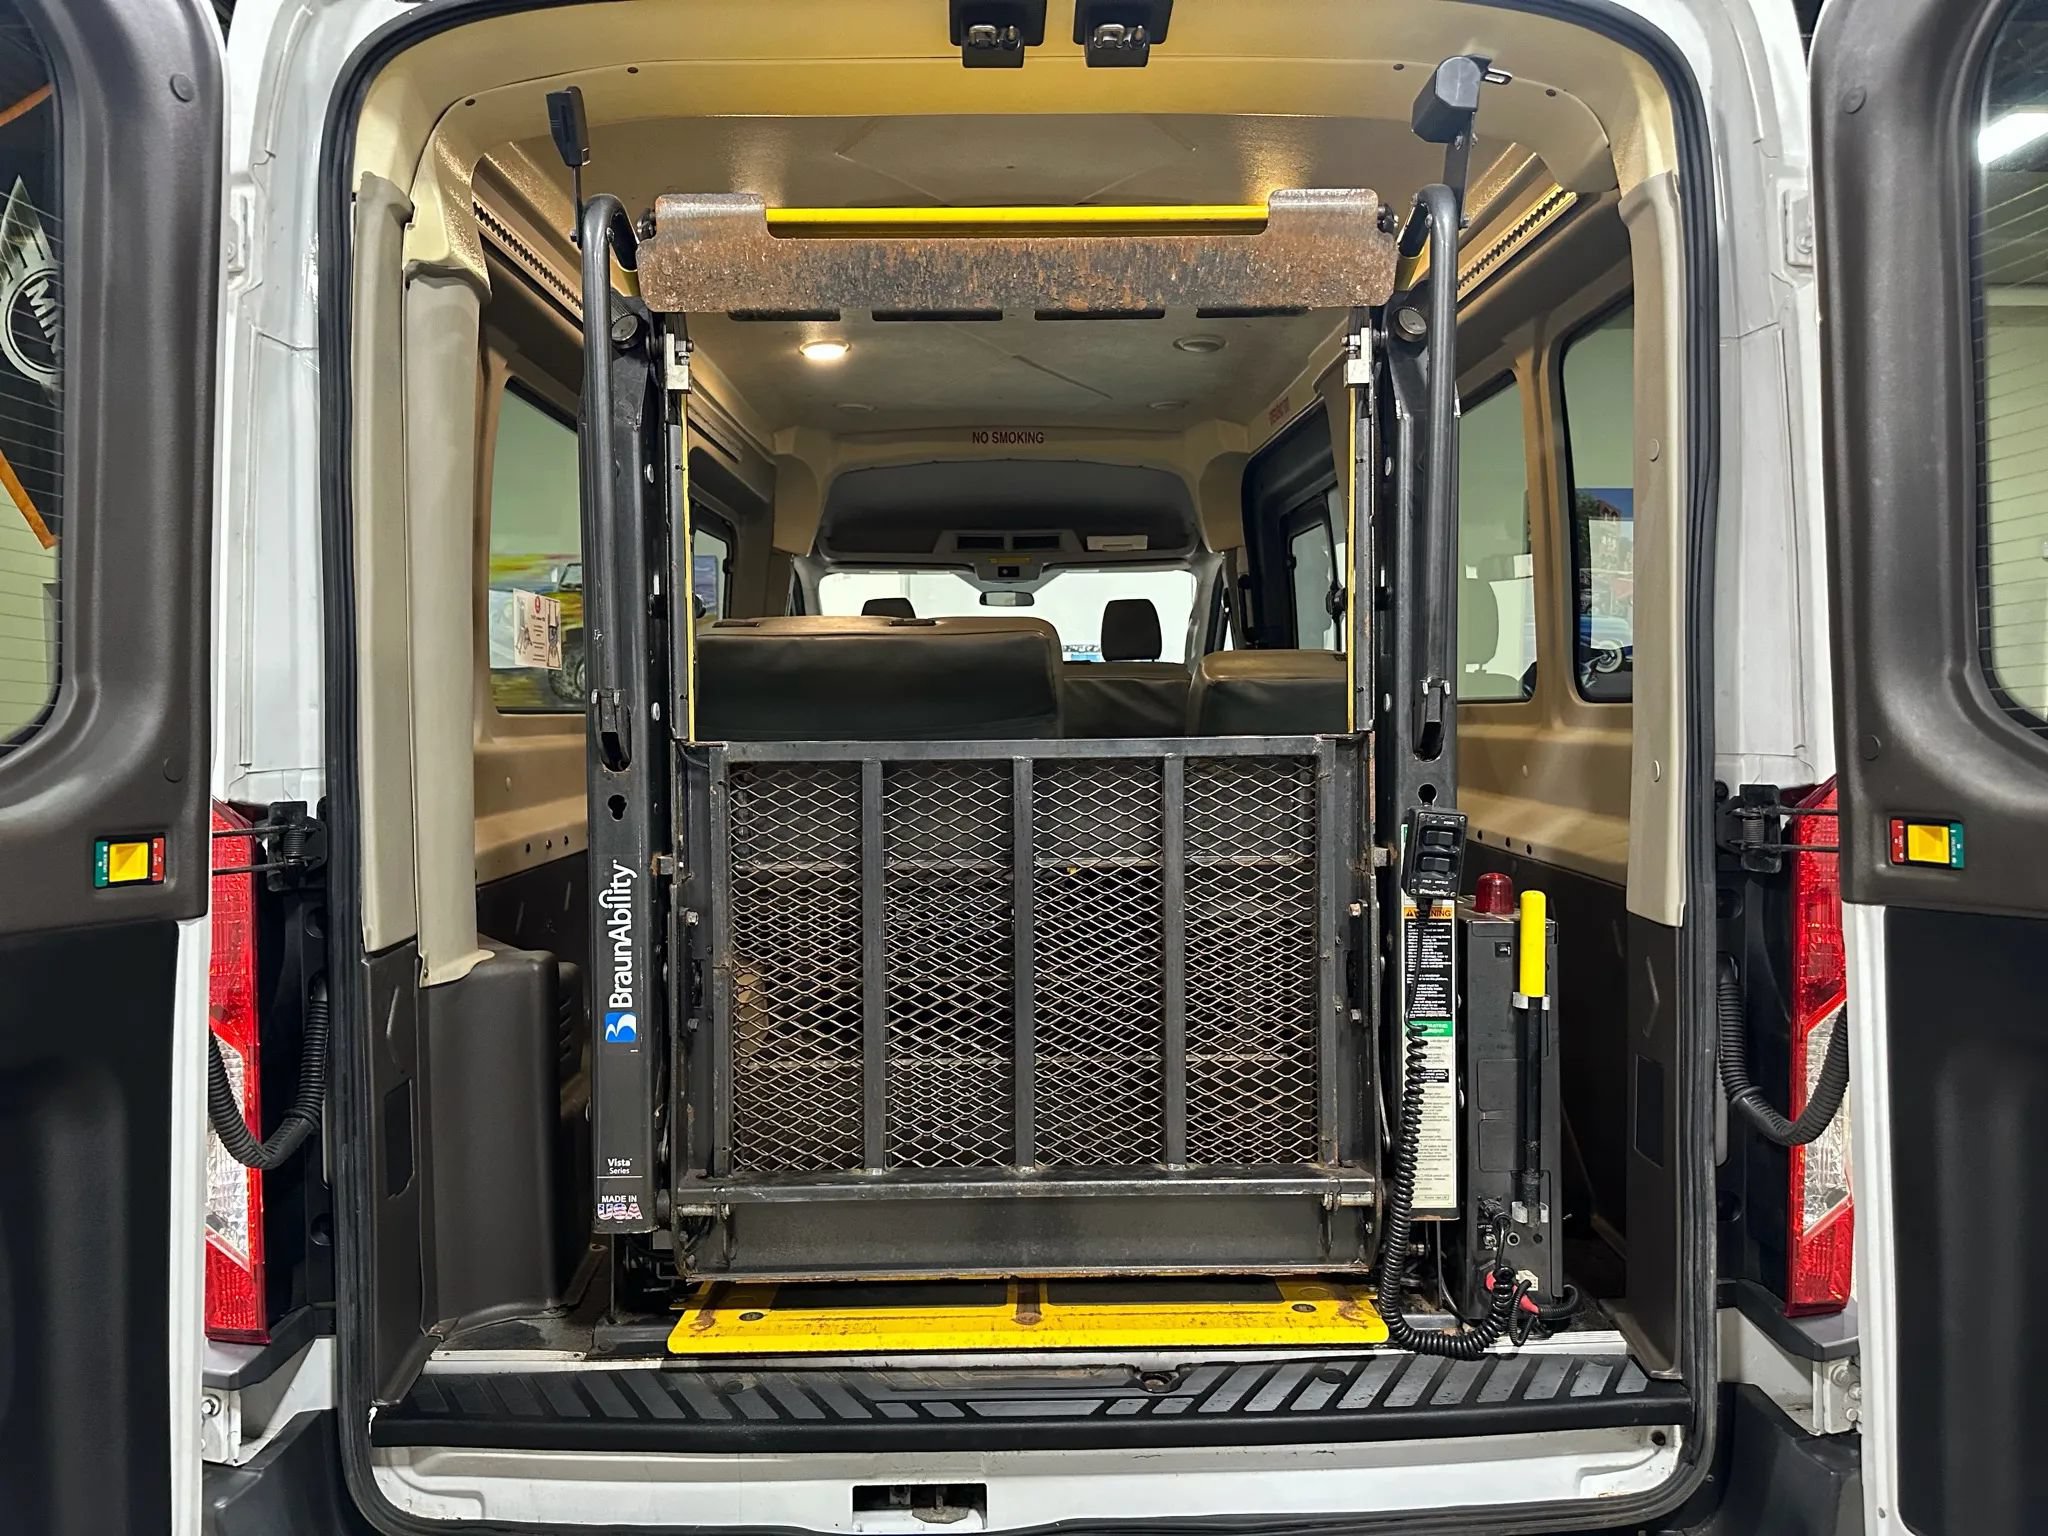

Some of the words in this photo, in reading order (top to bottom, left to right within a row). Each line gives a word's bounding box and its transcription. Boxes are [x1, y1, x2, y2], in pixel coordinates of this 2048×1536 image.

[972, 431, 989, 444] NO
[992, 431, 1045, 444] SMOKING
[598, 860, 638, 1009] BraunAbility
[607, 1158, 631, 1167] Vista
[609, 1167, 630, 1175] Series
[601, 1195, 627, 1203] MADE
[628, 1195, 638, 1203] IN
[597, 1203, 644, 1220] USA
